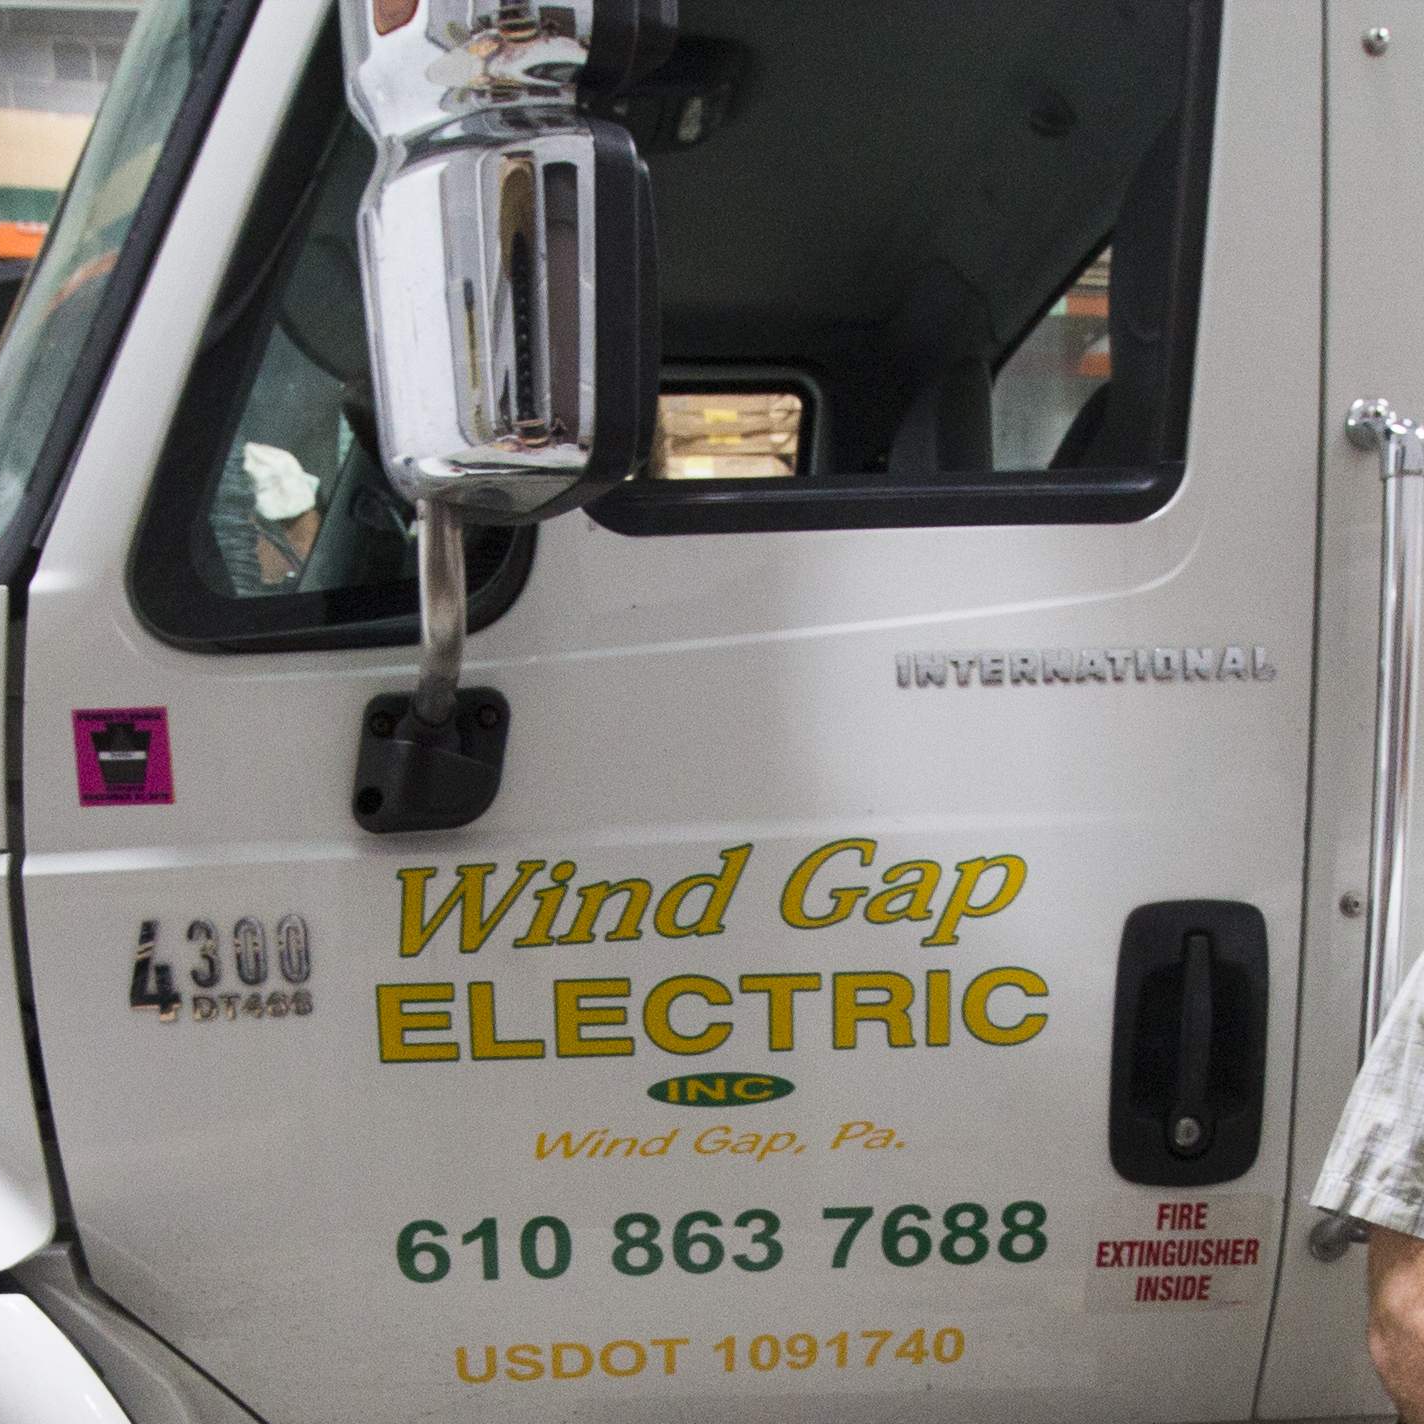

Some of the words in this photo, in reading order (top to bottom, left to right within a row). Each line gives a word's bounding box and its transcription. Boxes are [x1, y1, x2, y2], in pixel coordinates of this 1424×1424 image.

[895, 646, 1276, 690] INTERNATIONAL
[395, 842, 756, 958] Wind
[779, 837, 1029, 948] Gap
[130, 914, 313, 1022] 4300
[376, 967, 1049, 1063] ELECTRIC
[666, 1074, 776, 1104] INC
[533, 1127, 676, 1162] Wind
[691, 1125, 808, 1162] Gap,
[830, 1120, 907, 1151] Pa.
[1156, 1202, 1209, 1231] FIRE
[395, 1214, 574, 1284] 610
[611, 1207, 786, 1277] 863
[822, 1199, 1051, 1269] 7688
[1095, 1238, 1261, 1268] EXTINGUISHER
[1135, 1275, 1212, 1303] INSIDE
[454, 1337, 691, 1384] USDOT
[714, 1326, 966, 1374] 1091740
